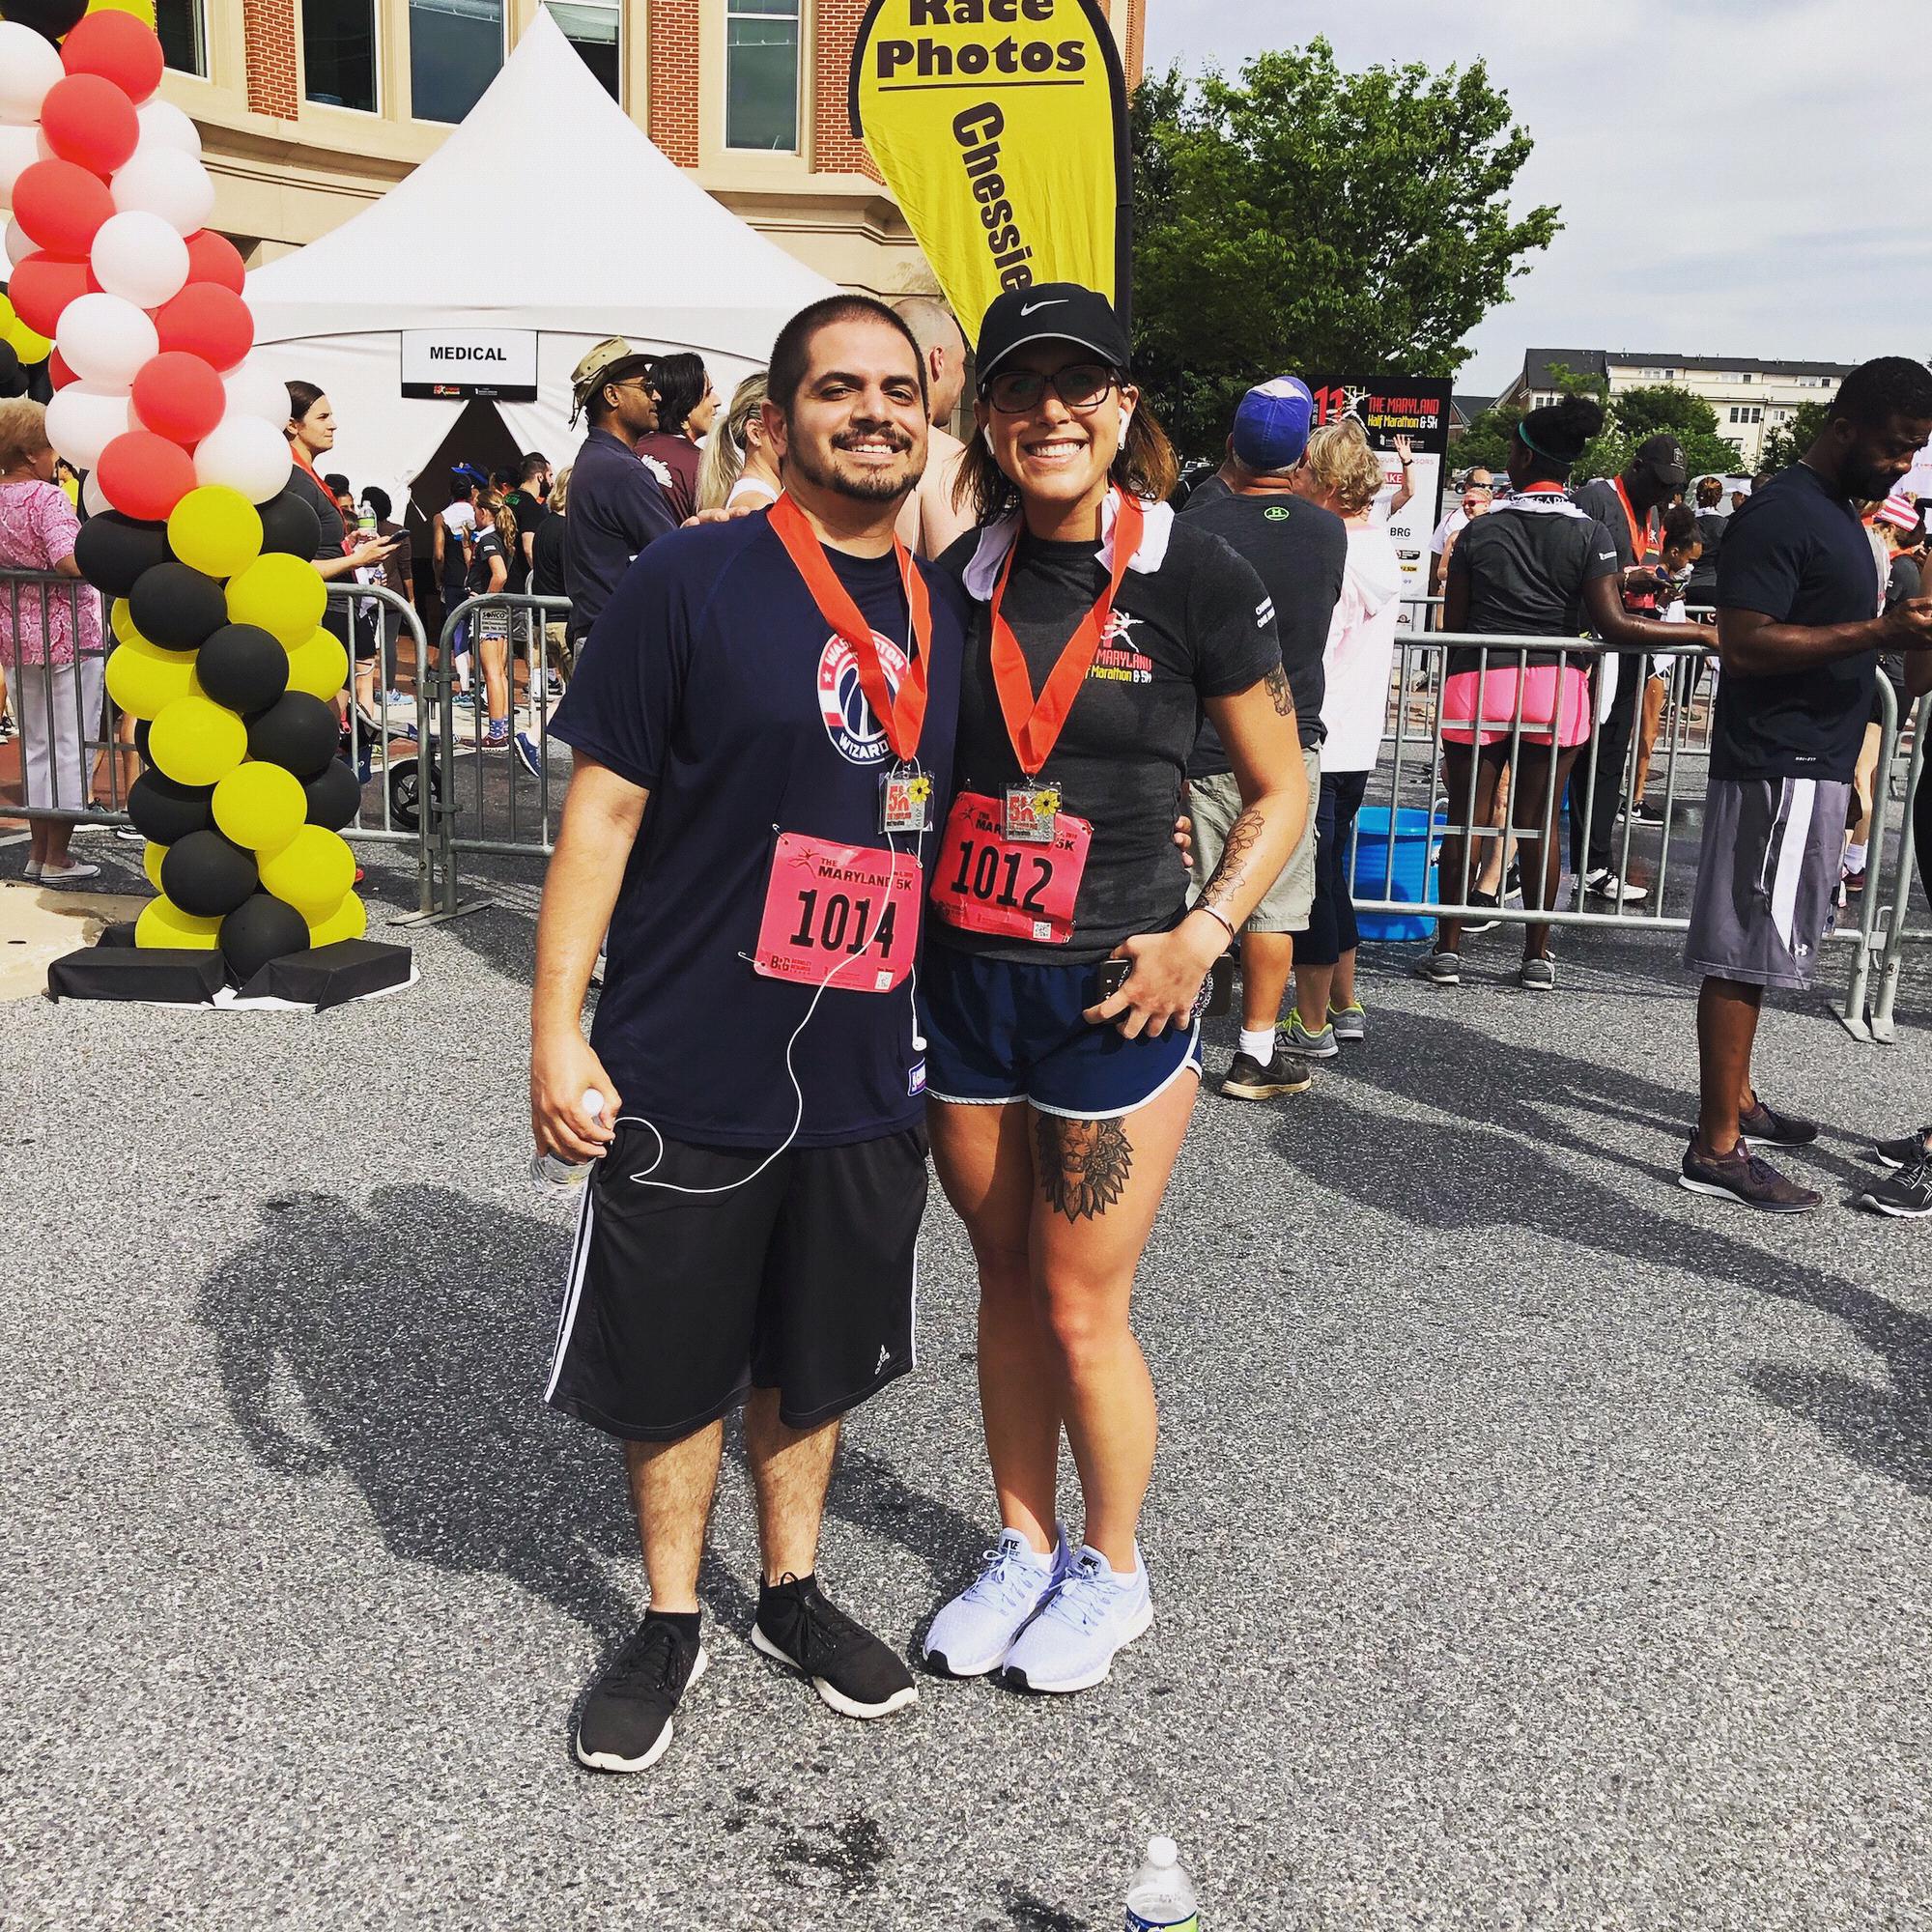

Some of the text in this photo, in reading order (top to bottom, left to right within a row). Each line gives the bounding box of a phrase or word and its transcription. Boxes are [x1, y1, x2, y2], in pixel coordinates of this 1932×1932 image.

[909, 0, 1054, 26] Race
[877, 36, 1086, 78] Photos
[952, 101, 1033, 290] Chessie
[430, 346, 507, 361] MEDICAL
[1368, 397, 1440, 415] THE MARYLAND
[1367, 413, 1382, 429] Half
[1383, 414, 1419, 428] Marathon
[1389, 526, 1411, 538] BRG
[824, 635, 906, 672] WASTON
[1091, 665, 1133, 682] Marathon
[838, 731, 889, 759] WIZARD
[1055, 838, 1075, 852] 5K
[821, 857, 838, 867] THE
[818, 866, 913, 891] MARYLAND 5K
[951, 839, 1054, 914] 1012
[789, 889, 896, 959] 1014
